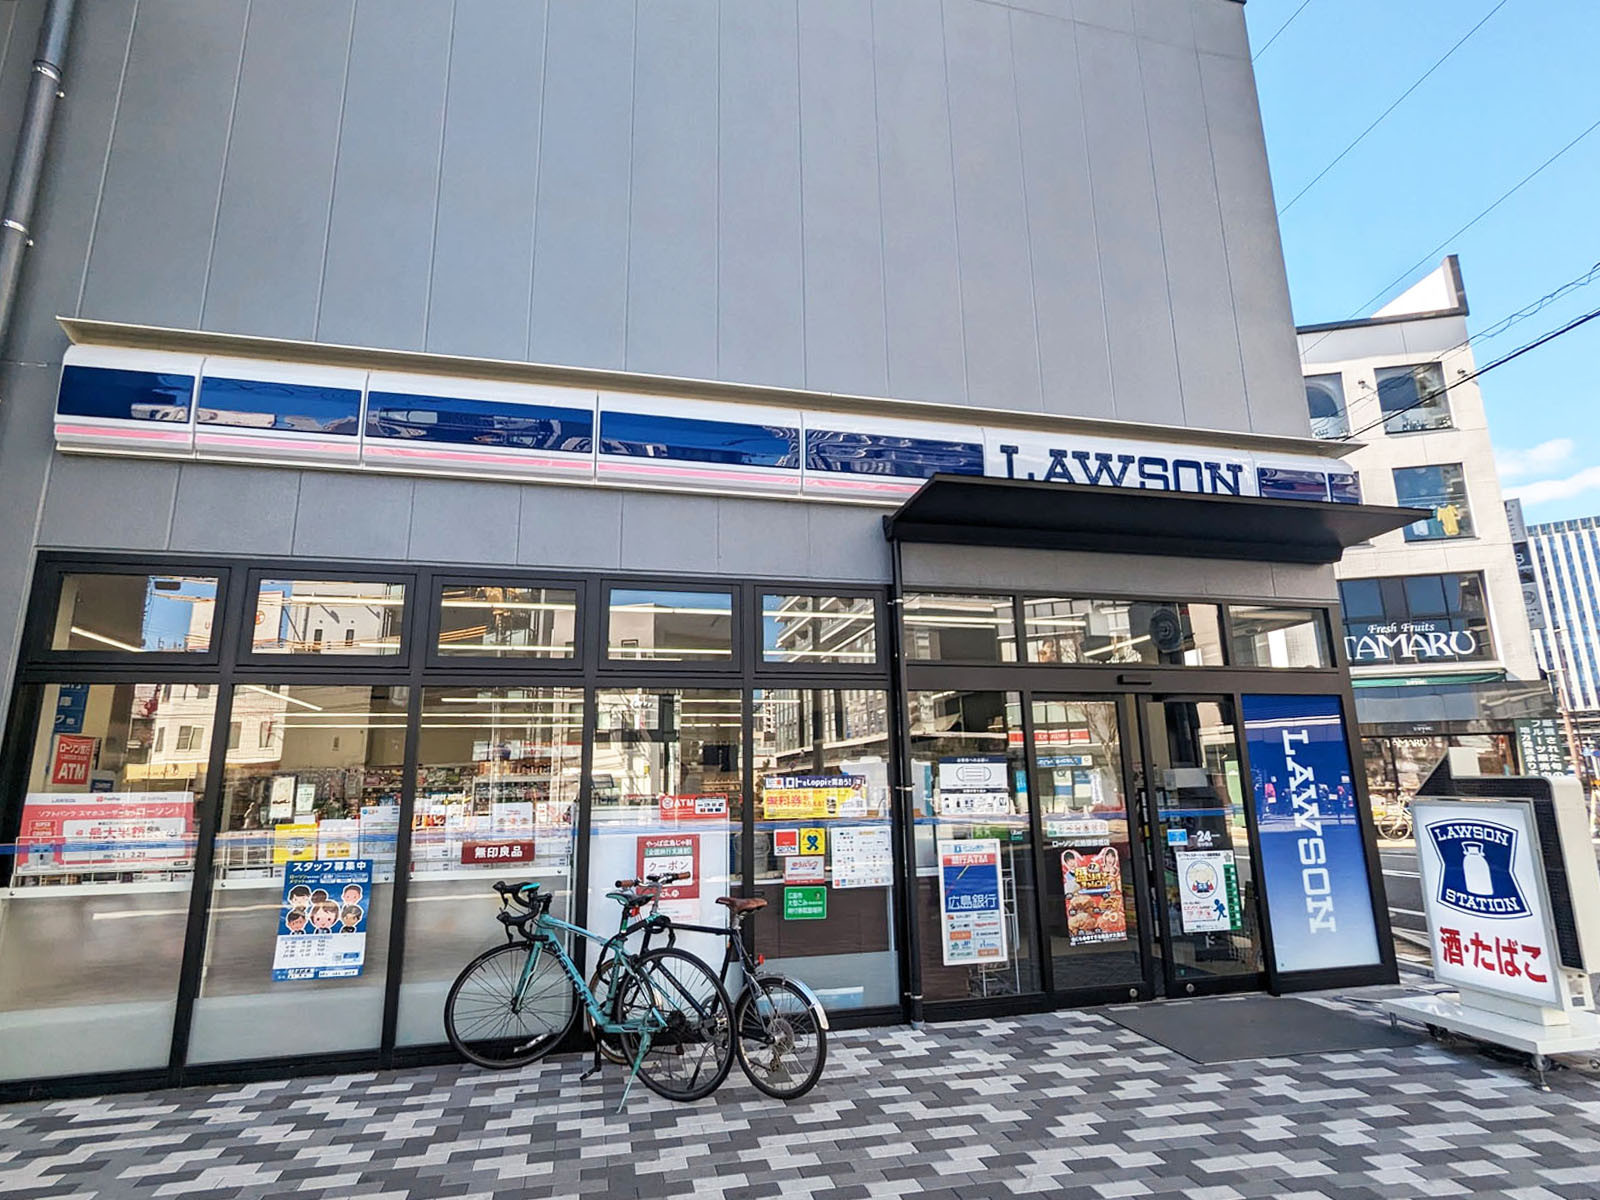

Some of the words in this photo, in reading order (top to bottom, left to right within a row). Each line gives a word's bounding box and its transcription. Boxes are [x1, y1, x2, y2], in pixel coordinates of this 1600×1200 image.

[1000, 444, 1243, 497] LAWSON
[1368, 623, 1397, 634] Fresh
[1401, 622, 1435, 632] Fruits
[1344, 631, 1476, 660] TAMARU
[58, 763, 86, 779] ATM
[675, 799, 694, 807] ATM
[1196, 830, 1212, 842] 24
[1282, 729, 1336, 934] LAWSON
[1435, 825, 1510, 847] LAWSON
[474, 845, 523, 859] 無印良品
[292, 861, 367, 872] スタッフ募集中
[649, 860, 689, 872] クーポン
[947, 893, 997, 910] 広島銀行
[1445, 888, 1520, 913] STATION
[1440, 926, 1548, 983] 酒・たばこ
